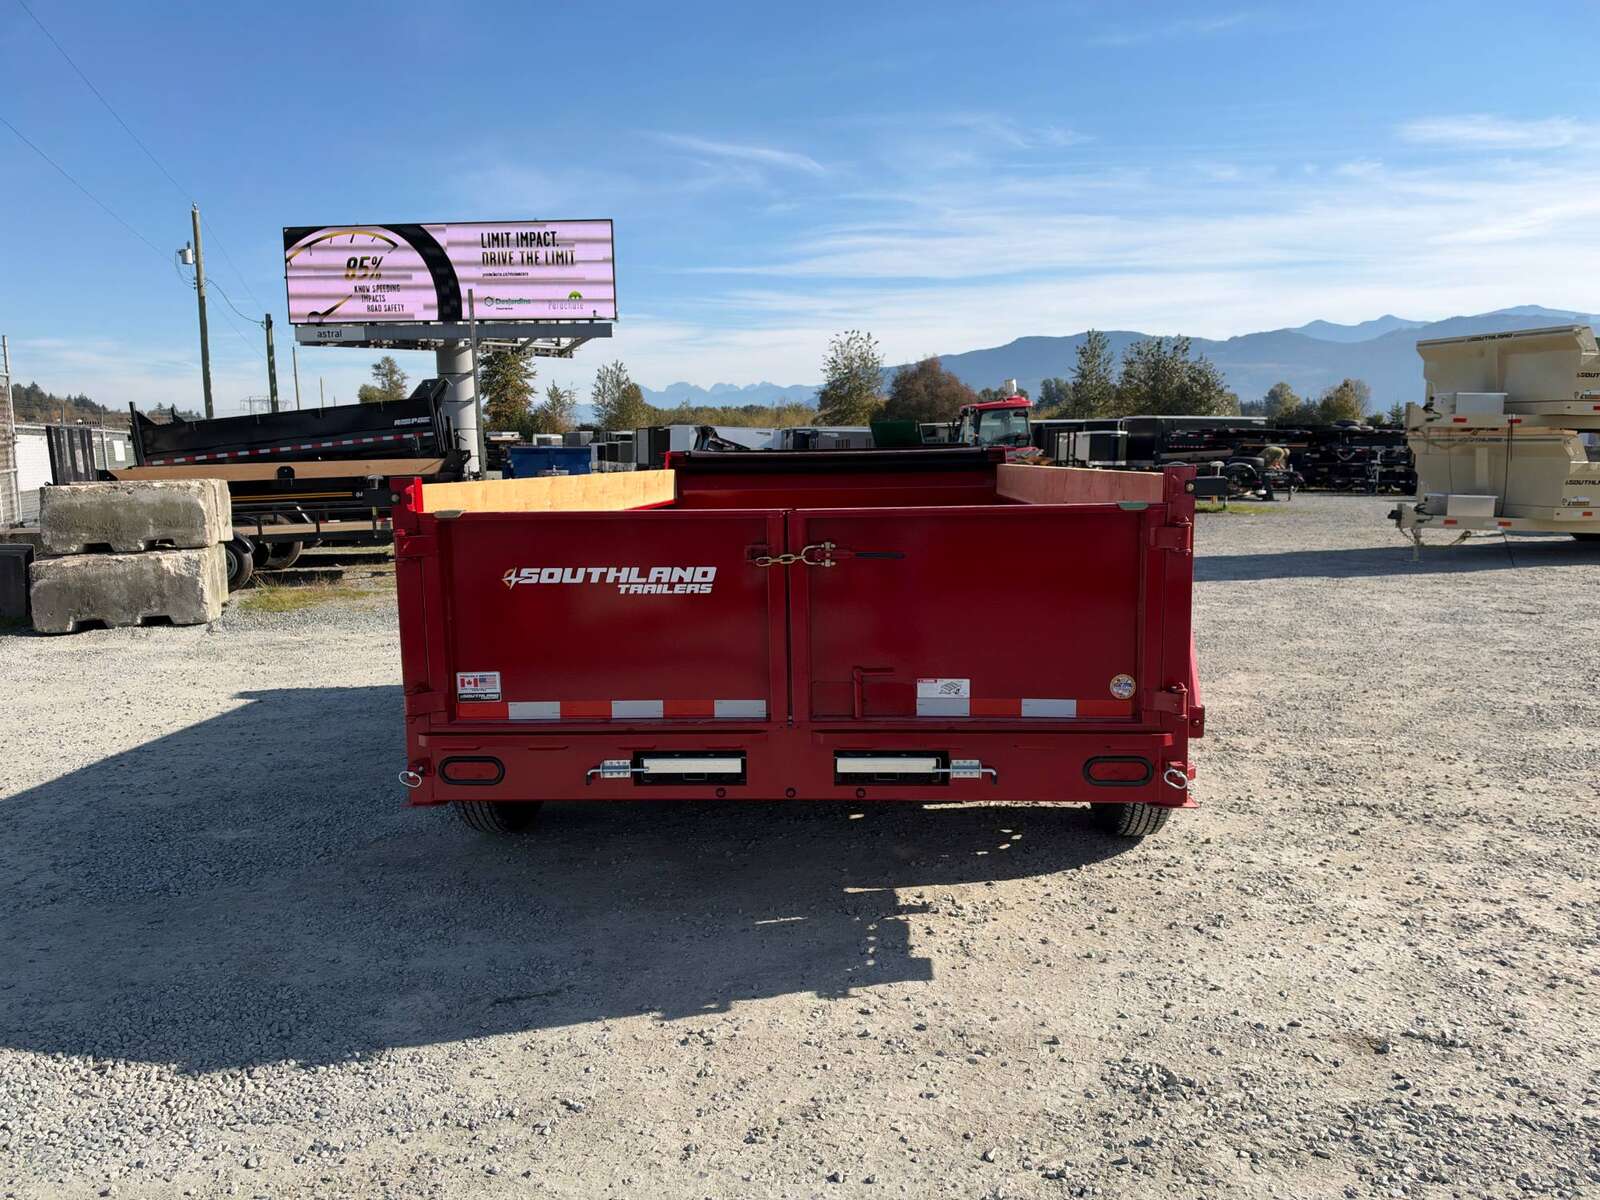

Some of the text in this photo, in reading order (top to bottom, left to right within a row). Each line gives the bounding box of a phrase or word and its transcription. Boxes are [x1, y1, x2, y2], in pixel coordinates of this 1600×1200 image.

[481, 231, 559, 248] LIMIT IMPACT.
[482, 250, 575, 266] DRIVE THE LIMIT
[345, 256, 383, 280] 85%
[354, 285, 370, 293] KNOW
[361, 294, 386, 303] IMPACTS
[367, 304, 404, 312] ROAD SAFETY
[317, 330, 342, 338] astral
[518, 567, 717, 584] SOUTHLAND
[617, 584, 713, 595] TRAILERS
